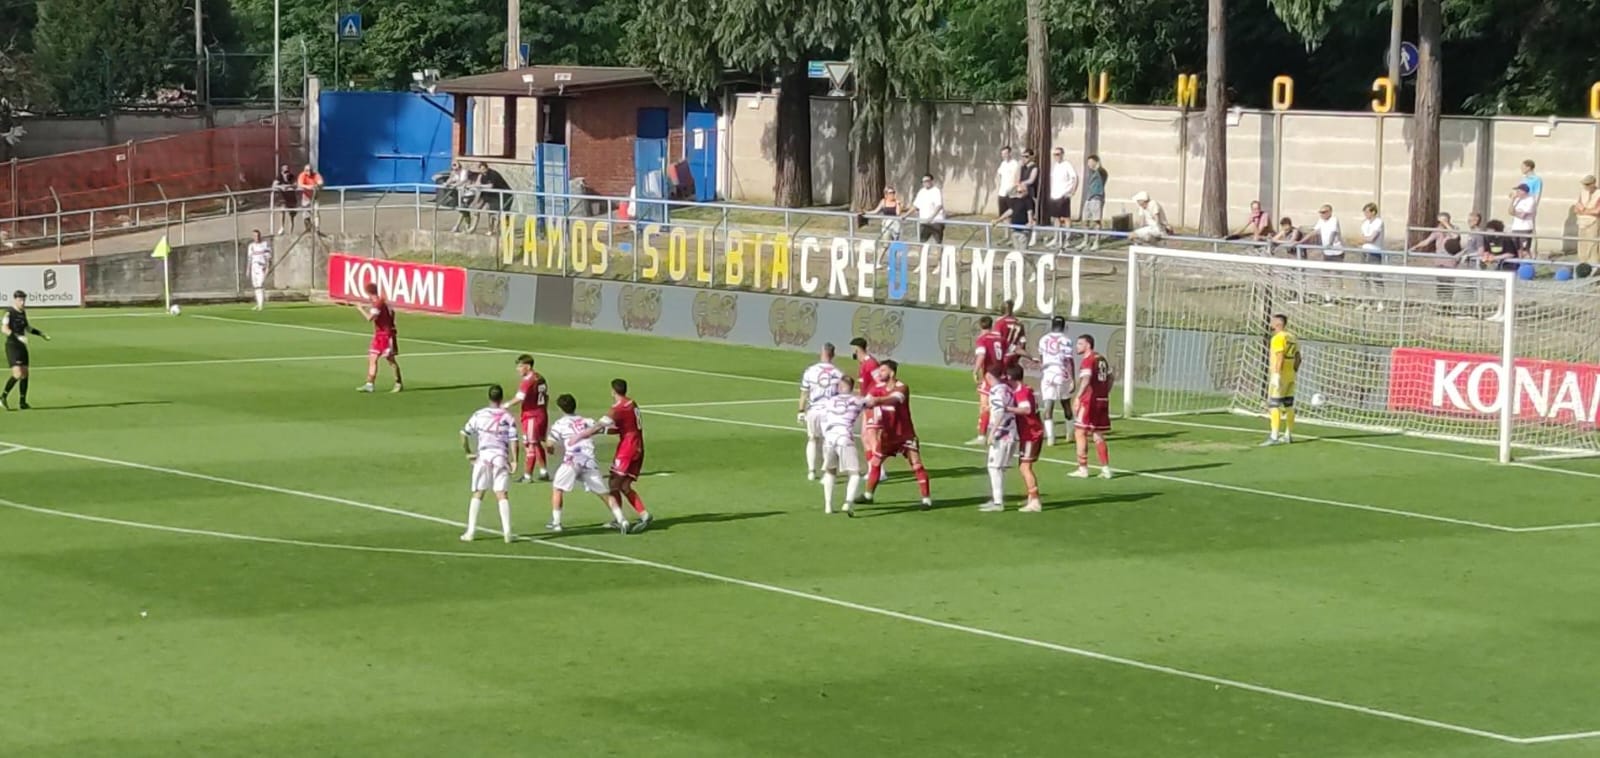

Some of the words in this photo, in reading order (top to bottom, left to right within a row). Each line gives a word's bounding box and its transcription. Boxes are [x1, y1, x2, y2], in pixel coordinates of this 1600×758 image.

[344, 260, 444, 307] KONAMI
[501, 213, 608, 275] VAMOS
[642, 225, 789, 290] SOLBIA
[800, 236, 1080, 317] CREDIAMOCI
[28, 291, 73, 303] bitpanda
[1007, 324, 1020, 343] 77
[1432, 358, 1600, 422] KONA
